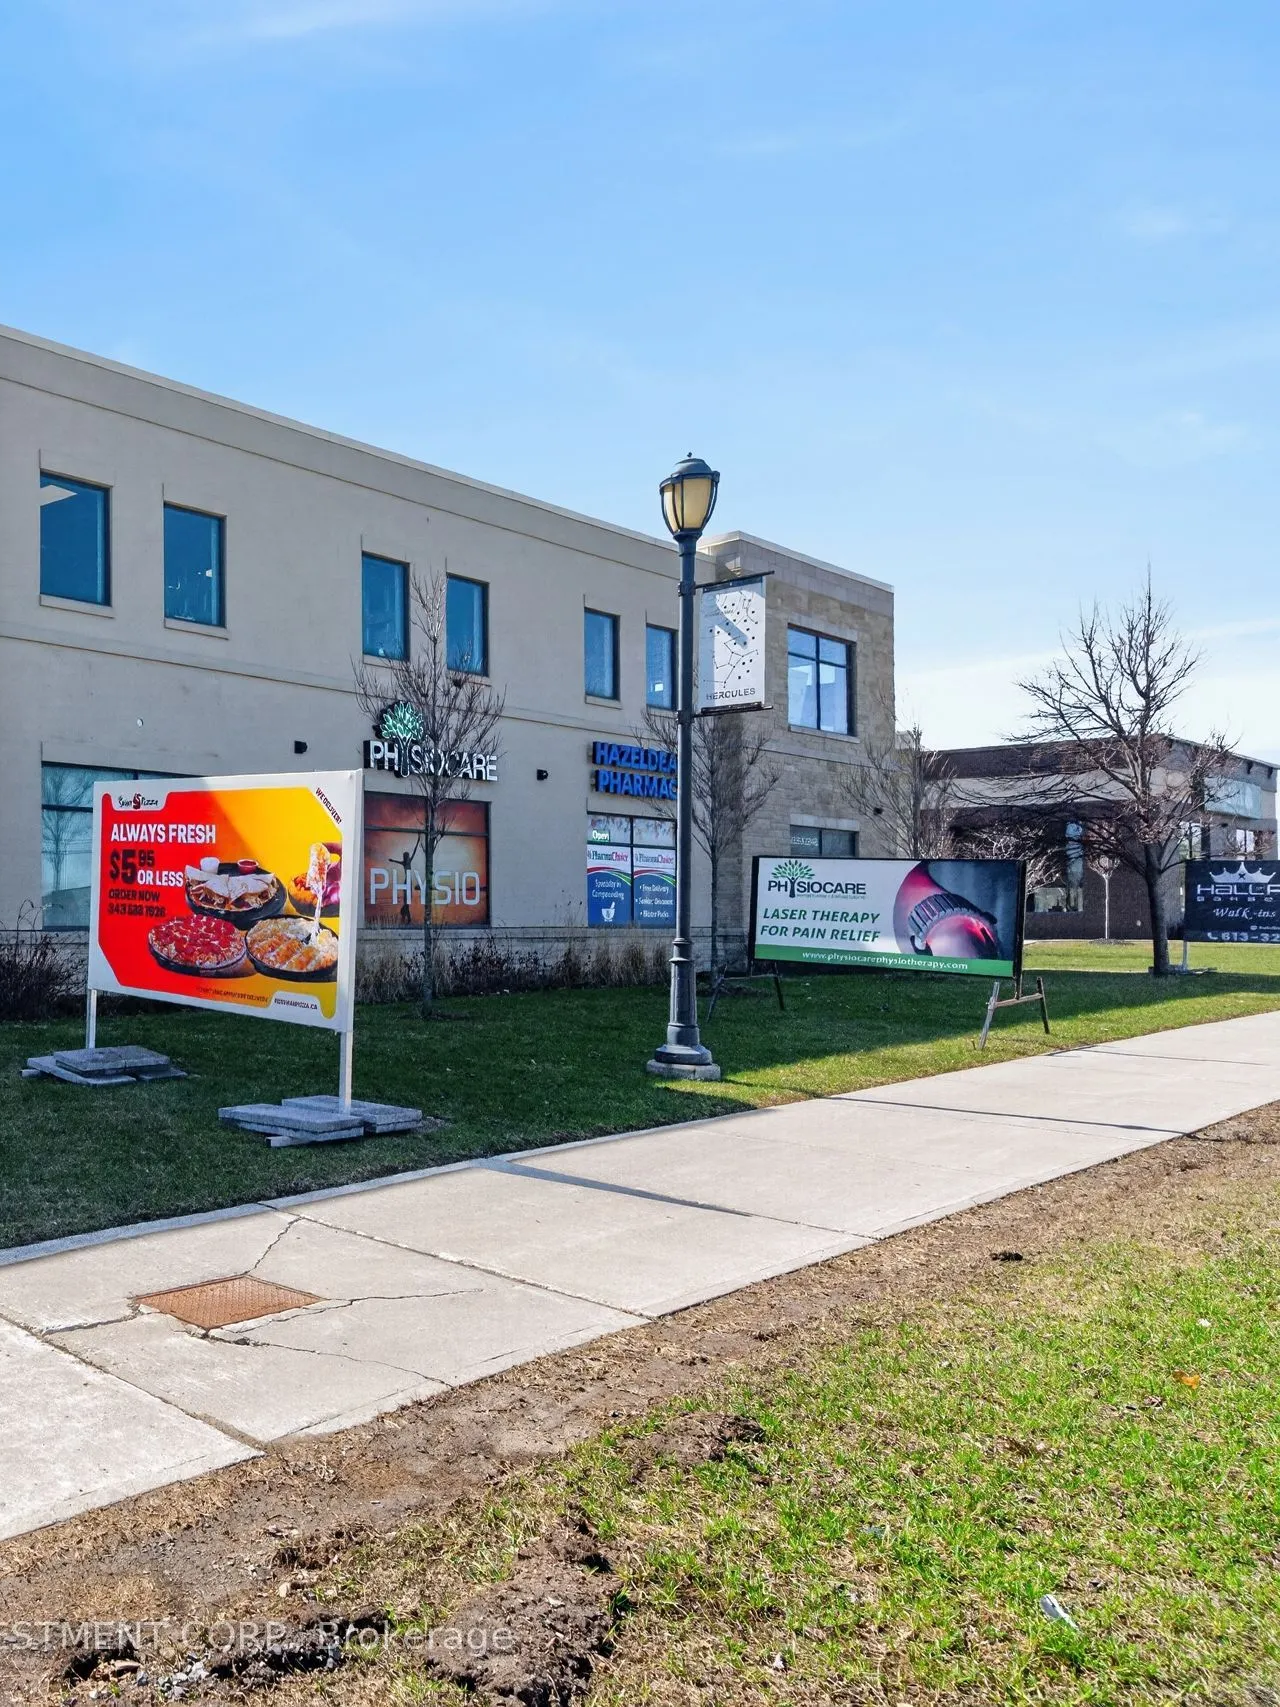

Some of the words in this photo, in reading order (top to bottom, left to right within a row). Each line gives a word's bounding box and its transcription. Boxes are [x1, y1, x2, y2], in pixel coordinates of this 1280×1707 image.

[706, 687, 756, 700] HERCULES
[595, 741, 677, 774] HAZELDEA
[598, 769, 677, 801] PHARMAC
[110, 823, 166, 843] ALWAYS
[168, 824, 216, 844] FRESH
[592, 829, 609, 840] Open
[109, 849, 136, 885] $5
[137, 869, 154, 885] OR
[156, 871, 184, 887] LESS
[370, 867, 480, 905] PHYSIO
[768, 877, 867, 898] PHYSIOCARE
[109, 889, 137, 900] ORDER
[139, 890, 160, 902] NOW
[763, 908, 807, 920] LASER
[812, 910, 880, 924] THERAPY
[760, 925, 789, 937] FOR
[792, 926, 826, 939] PAIN
[830, 928, 881, 942] RELIEF
[802, 951, 968, 970] www.physiocarephysiotherapy.com
